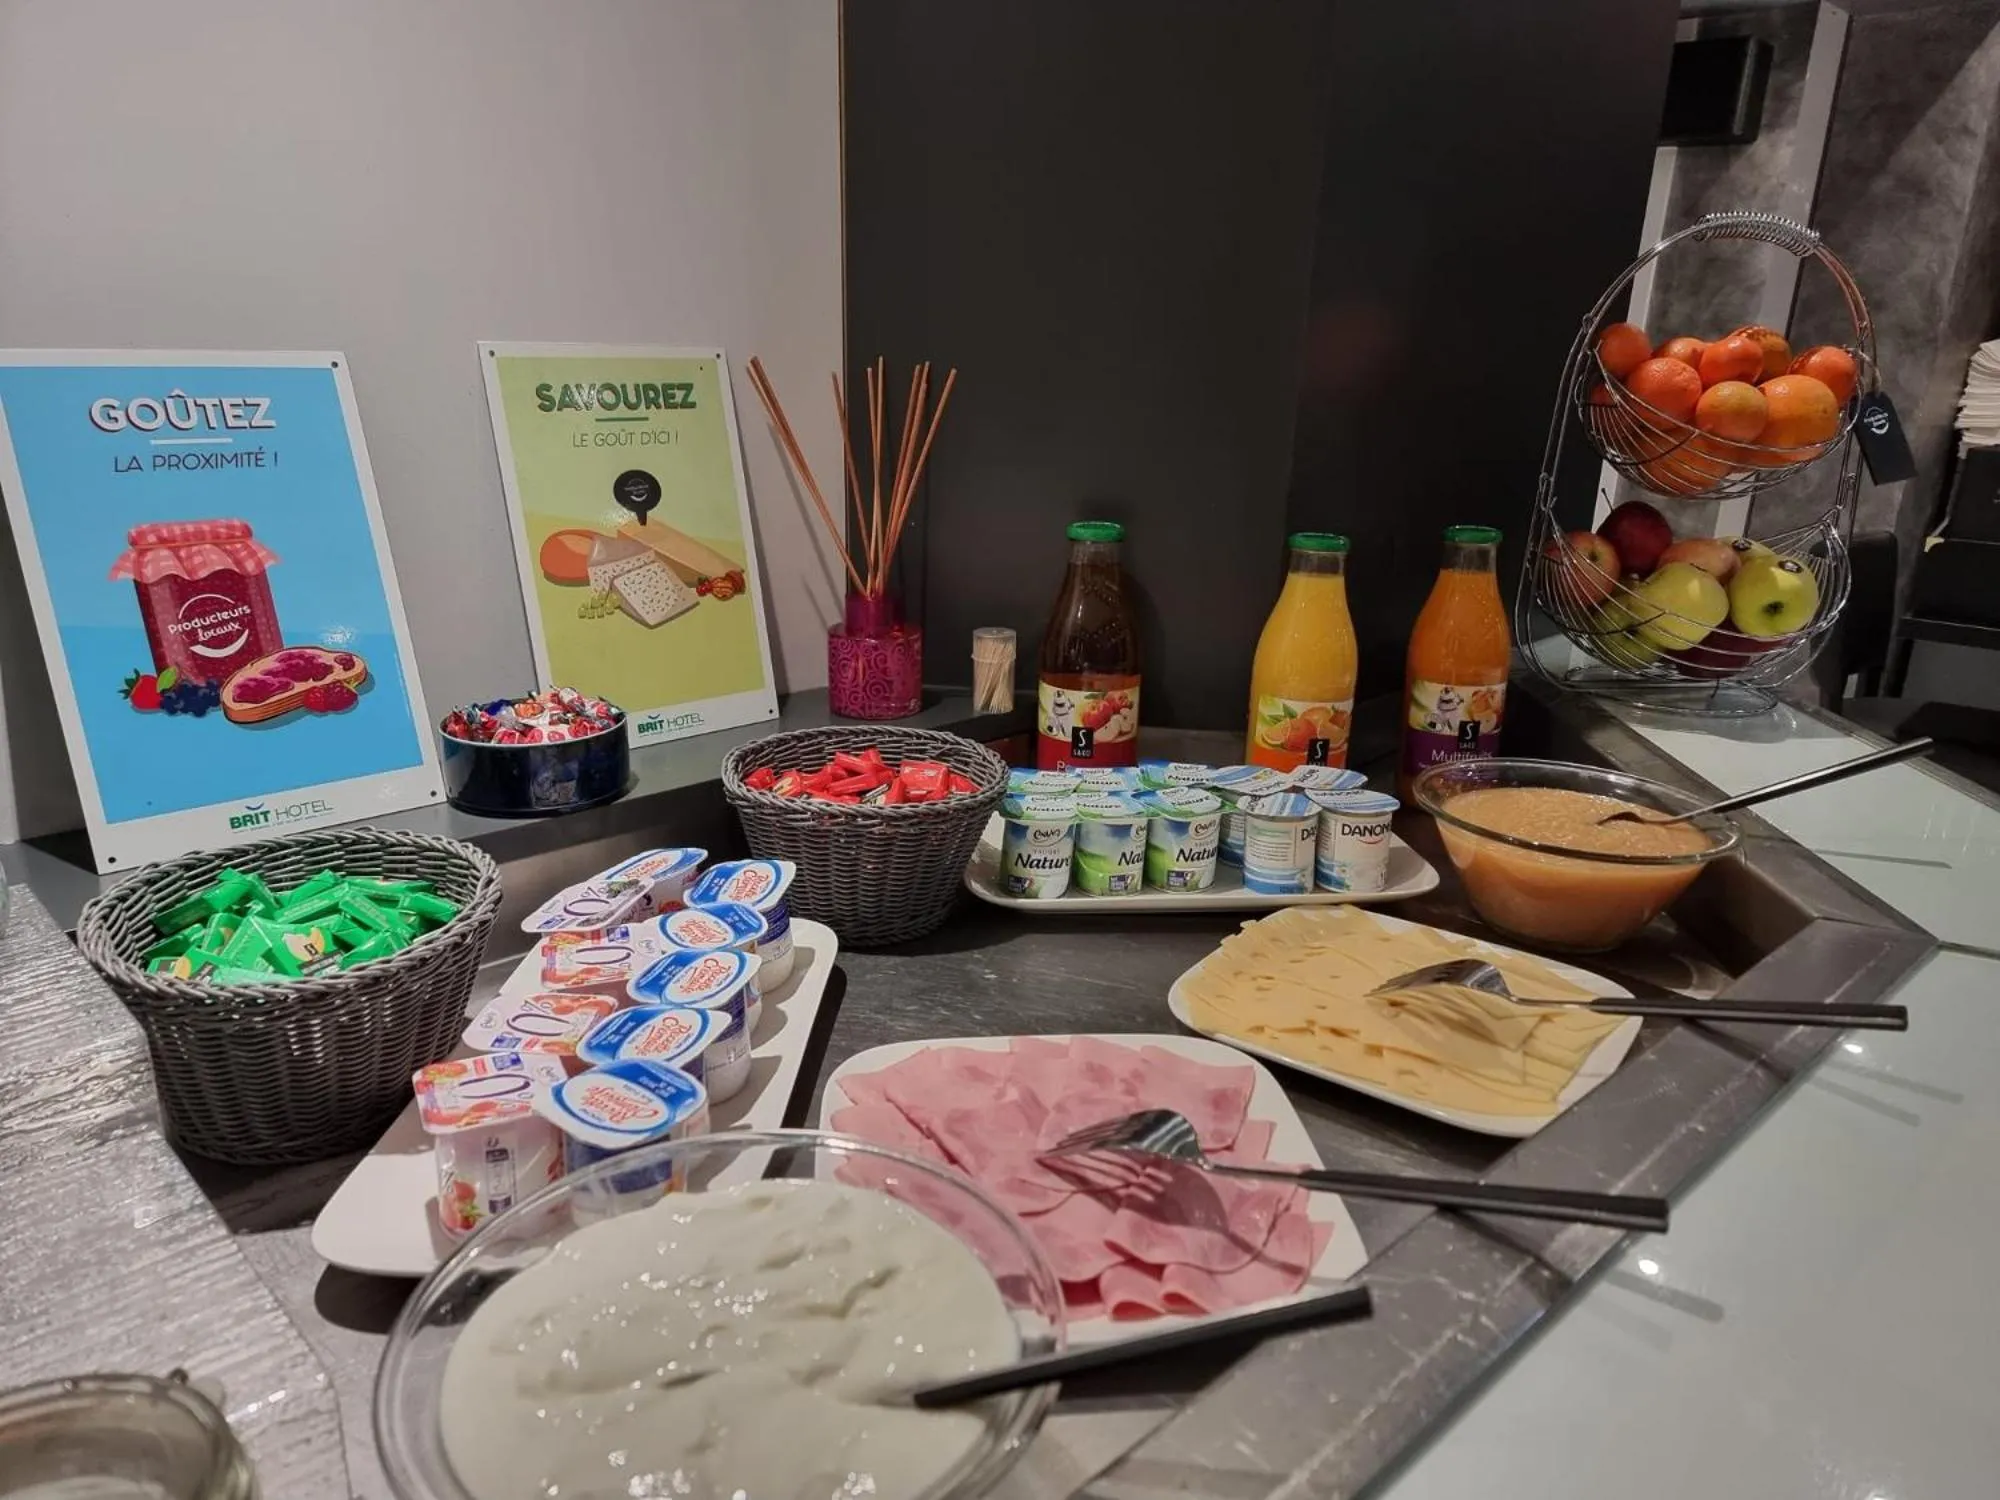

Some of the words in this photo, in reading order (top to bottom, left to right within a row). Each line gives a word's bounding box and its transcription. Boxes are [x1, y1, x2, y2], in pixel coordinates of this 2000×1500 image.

[535, 383, 697, 412] SAVOUREZ
[89, 388, 277, 433] GOÛTEZ
[572, 432, 588, 447] LE
[593, 428, 635, 447] GOÛT
[113, 455, 144, 473] LA
[152, 445, 266, 472] PROXIMITÉ
[167, 605, 252, 635] Producteurs
[638, 719, 665, 734] BRIT
[667, 712, 705, 729] HOTEL
[229, 810, 271, 830] BRIT
[275, 800, 335, 820] HOTEL
[1341, 822, 1391, 837] DANON
[1014, 853, 1070, 869] Natur
[1118, 851, 1144, 866] Na
